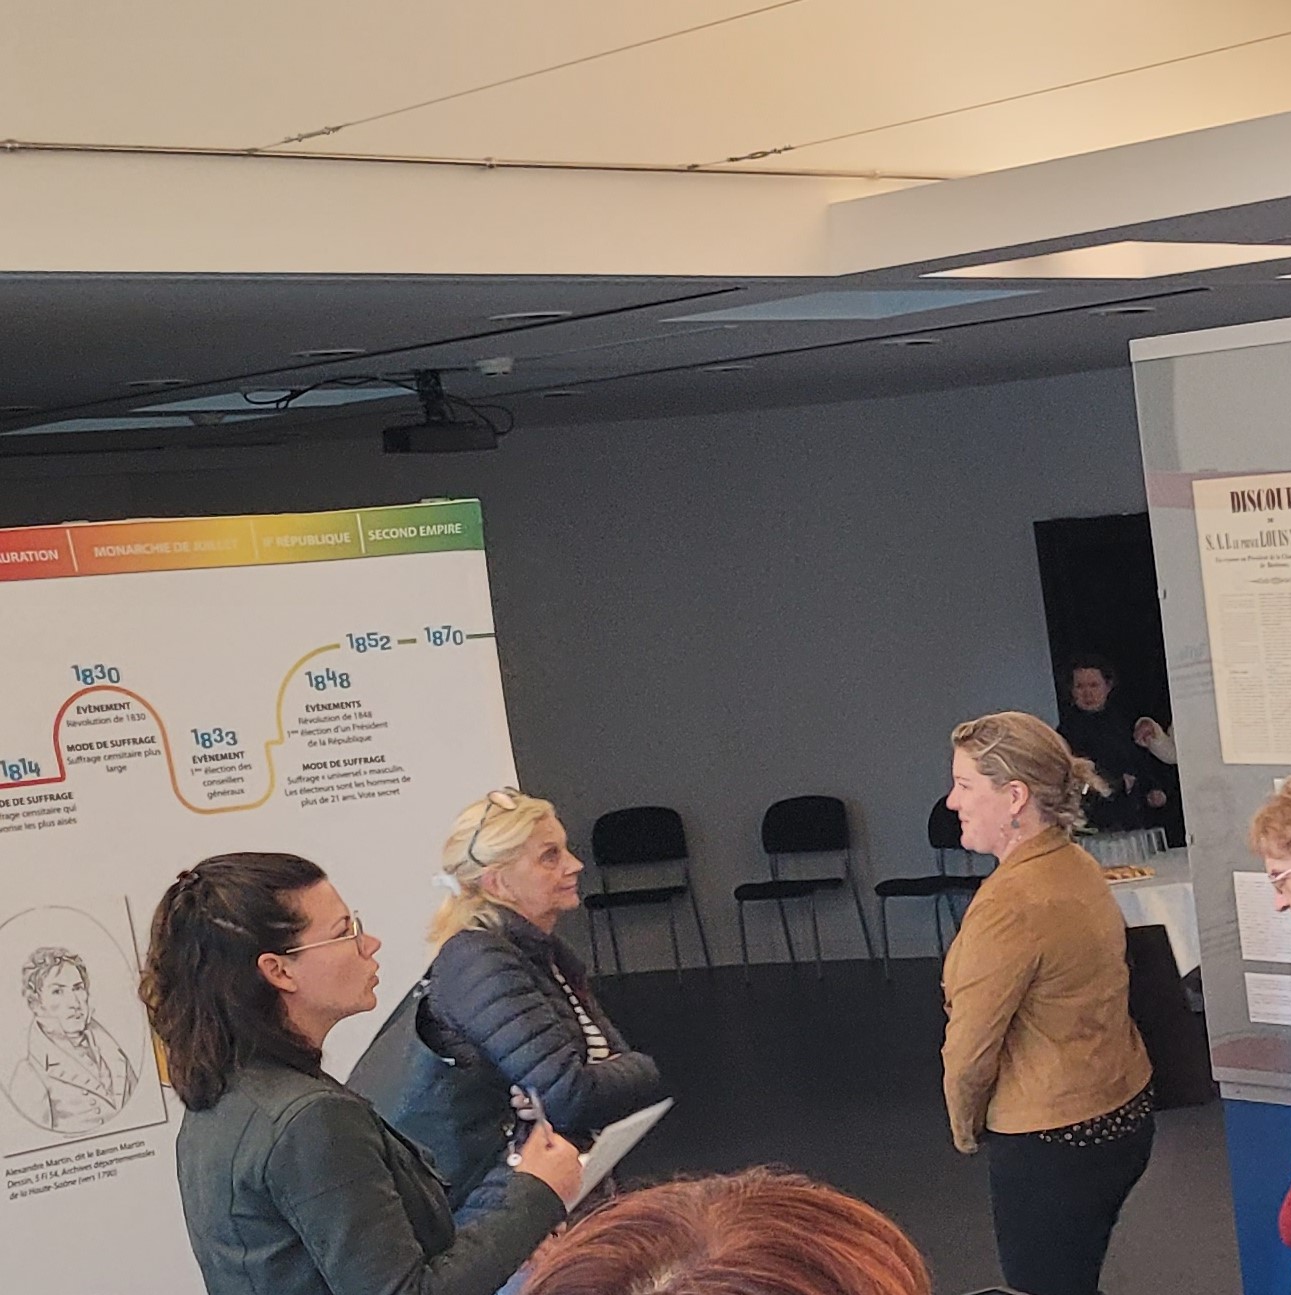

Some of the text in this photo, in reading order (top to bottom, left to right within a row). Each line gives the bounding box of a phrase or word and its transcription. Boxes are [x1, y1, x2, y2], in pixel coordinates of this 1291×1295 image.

[276, 531, 351, 548] RÉPUBLIQUE
[368, 523, 462, 541] SECOND EMPIRE
[94, 542, 170, 558] MONARCHIE
[174, 540, 191, 552] DE
[346, 632, 392, 653] 1852
[424, 625, 463, 647] 1870
[71, 664, 121, 685] 1830
[305, 668, 351, 691] 1848
[66, 713, 146, 728] Révolution de 1830
[298, 711, 373, 725] Révolution de 1848
[191, 727, 238, 749] 1833
[300, 725, 332, 736] élection
[66, 736, 156, 752] MODE DE SUFFRAGE
[307, 739, 318, 748] de
[327, 735, 372, 746] République
[67, 748, 161, 766] Suffrage censitaire plus
[302, 755, 386, 771] MODE DE SUFFRAGE
[0, 757, 41, 781] 1814
[106, 763, 127, 774] large
[203, 764, 236, 775] élection
[238, 762, 252, 772] des
[202, 775, 244, 788] conseillers
[287, 774, 320, 785] Suffrage
[327, 769, 362, 780] universel
[206, 788, 245, 800] généraux
[284, 787, 298, 797] Les
[299, 784, 335, 795] électeurs
[336, 783, 353, 792] sont
[366, 776, 400, 787] hommes
[401, 775, 412, 783] de
[12, 796, 25, 807] DE
[26, 791, 74, 805] SUFFRAGE
[301, 797, 318, 808] plus
[318, 796, 329, 804] de
[330, 794, 340, 803] 21
[22, 806, 61, 818] censitaire
[63, 803, 77, 814] qui
[24, 822, 36, 830] les
[38, 820, 56, 830] plus
[57, 817, 77, 826] aisés
[5, 1162, 44, 1177] Alexandre
[74, 1152, 86, 1162] dit
[119, 1139, 145, 1151] Martin
[9, 1191, 18, 1200] de
